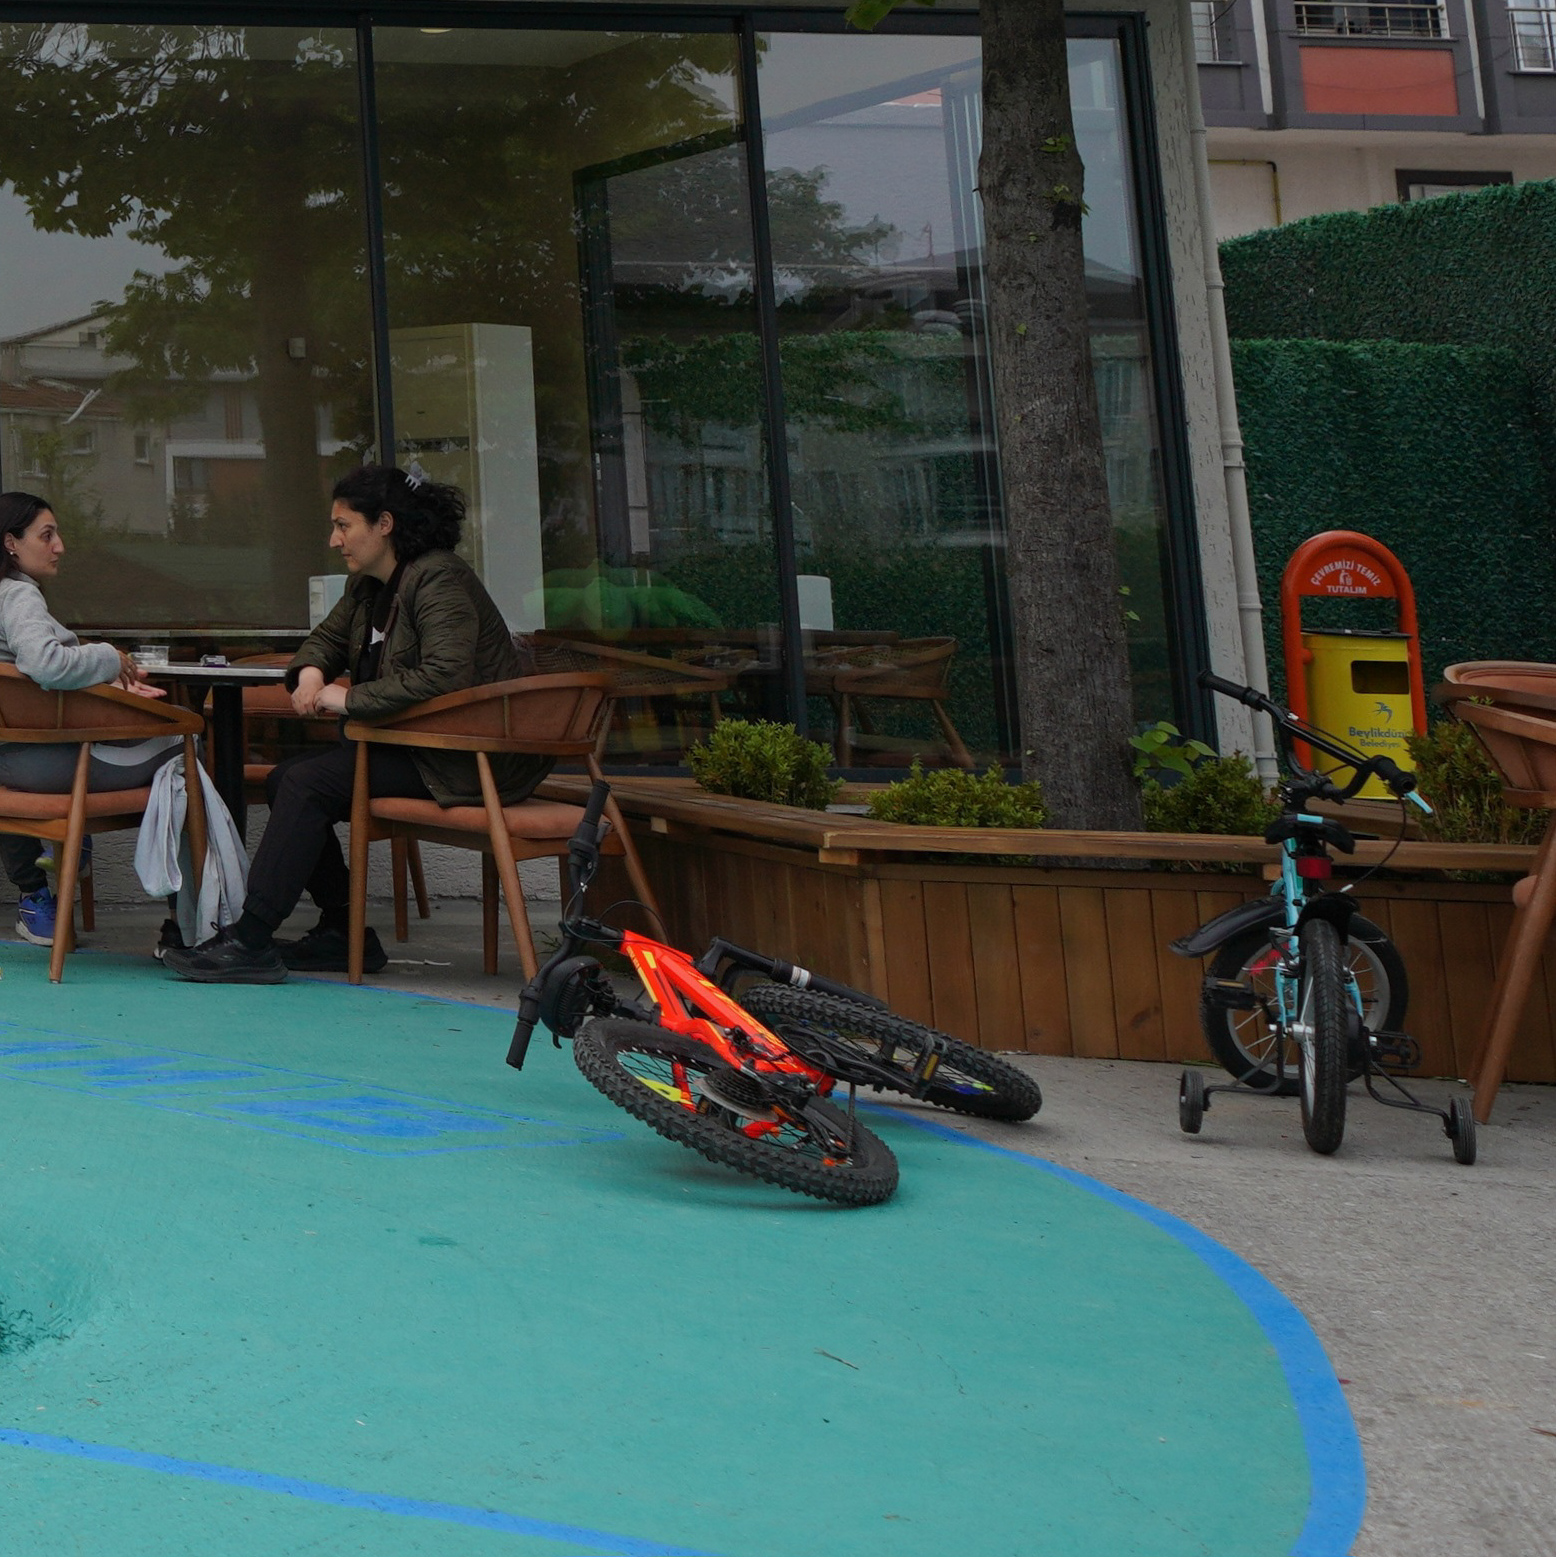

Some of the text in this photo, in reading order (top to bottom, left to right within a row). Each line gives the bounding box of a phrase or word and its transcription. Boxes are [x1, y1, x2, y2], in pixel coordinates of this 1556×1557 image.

[1310, 559, 1382, 587] ÇEVREMİZİ TEMİZ
[1326, 585, 1367, 594] TUTALIM
